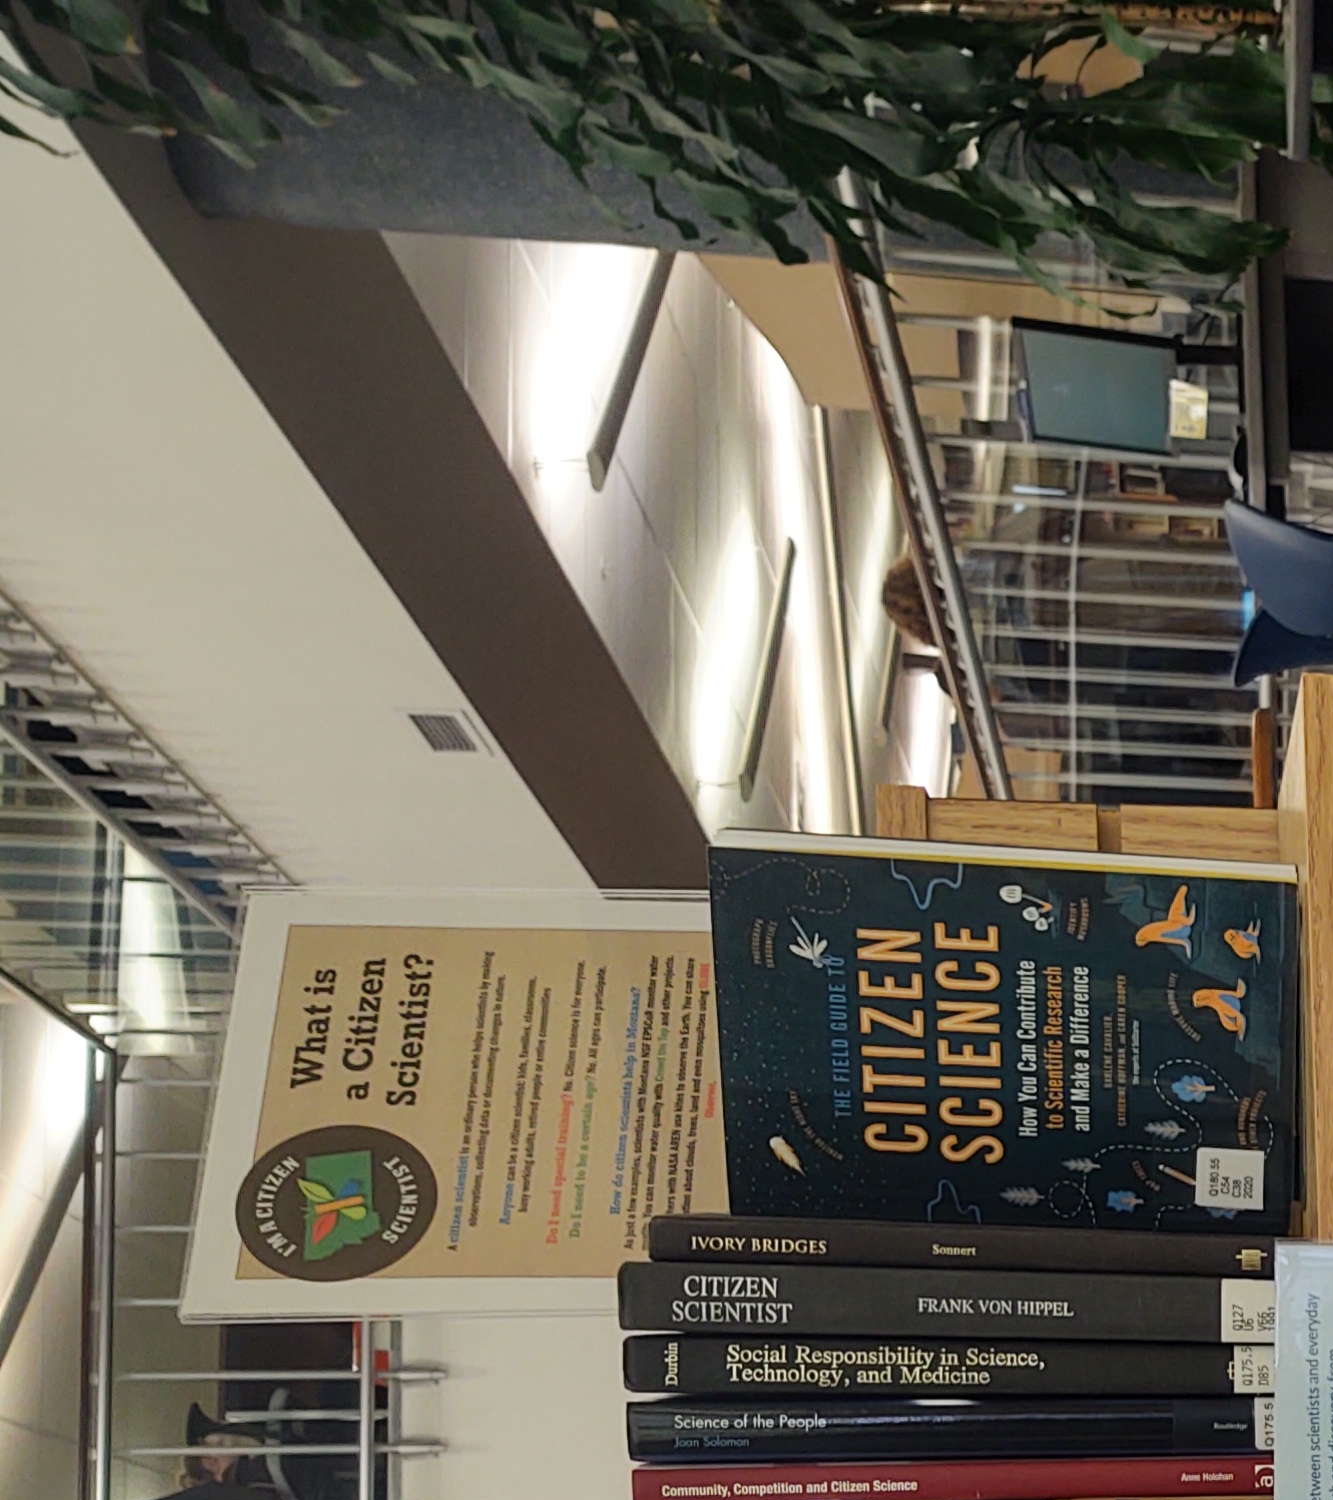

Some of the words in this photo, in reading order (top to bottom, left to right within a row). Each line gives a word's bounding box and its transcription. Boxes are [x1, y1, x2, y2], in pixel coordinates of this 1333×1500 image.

[826, 954, 845, 976] TO
[304, 969, 336, 995] is
[828, 983, 848, 1031] GUIDE
[1016, 960, 1036, 1039] Contribute
[1042, 966, 1063, 1035] Research
[1069, 966, 1089, 1044] Difference
[342, 959, 386, 1071] Citizen
[387, 954, 434, 1106] Scientist?
[856, 927, 929, 1153] CITIZEN
[934, 921, 1004, 1165] SCIENCE
[290, 1005, 333, 1088] What
[1017, 1044, 1037, 1072] Can
[1075, 1049, 1089, 1058] a
[831, 1039, 850, 1082] FIELD
[1018, 1076, 1038, 1101] You
[1044, 1040, 1064, 1110] Scientific
[1070, 1062, 1090, 1101] Make
[347, 1082, 369, 1100] a
[834, 1090, 852, 1117] THE
[1018, 1106, 1039, 1137] How
[1045, 1114, 1064, 1129] to
[1071, 1106, 1090, 1131] and
[255, 1156, 299, 1218] CITIZEN
[381, 1155, 418, 1244] SCIENTIST
[1244, 1175, 1254, 1199] 2020
[260, 1220, 278, 1233] A
[690, 1235, 747, 1251] IVORY
[750, 1236, 828, 1254] BRIDGES
[683, 1275, 779, 1298] CITIZEN
[671, 1300, 793, 1324] SCIENTIST
[918, 1297, 975, 1314] FRANK
[978, 1299, 1013, 1315] VON
[1017, 1300, 1075, 1317] HIPPEL
[1306, 1294, 1322, 1356] everyday
[664, 1342, 679, 1386] Durbin
[726, 1344, 787, 1363] Social
[794, 1344, 934, 1368] Responsibility
[939, 1347, 959, 1366] in
[965, 1347, 1046, 1371] Science,
[726, 1363, 850, 1388] Technology,
[856, 1366, 892, 1384] and
[899, 1366, 991, 1385] Medicine
[1307, 1359, 1320, 1384] and
[674, 1415, 729, 1429] Science
[733, 1413, 749, 1429] of
[752, 1413, 775, 1429] the
[779, 1412, 827, 1432] People
[1307, 1387, 1321, 1452] scientists
[661, 1484, 731, 1497] Community,
[733, 1482, 803, 1496] Competition
[806, 1481, 828, 1494] and
[831, 1480, 870, 1493] Citizen
[872, 1479, 918, 1492] Science
